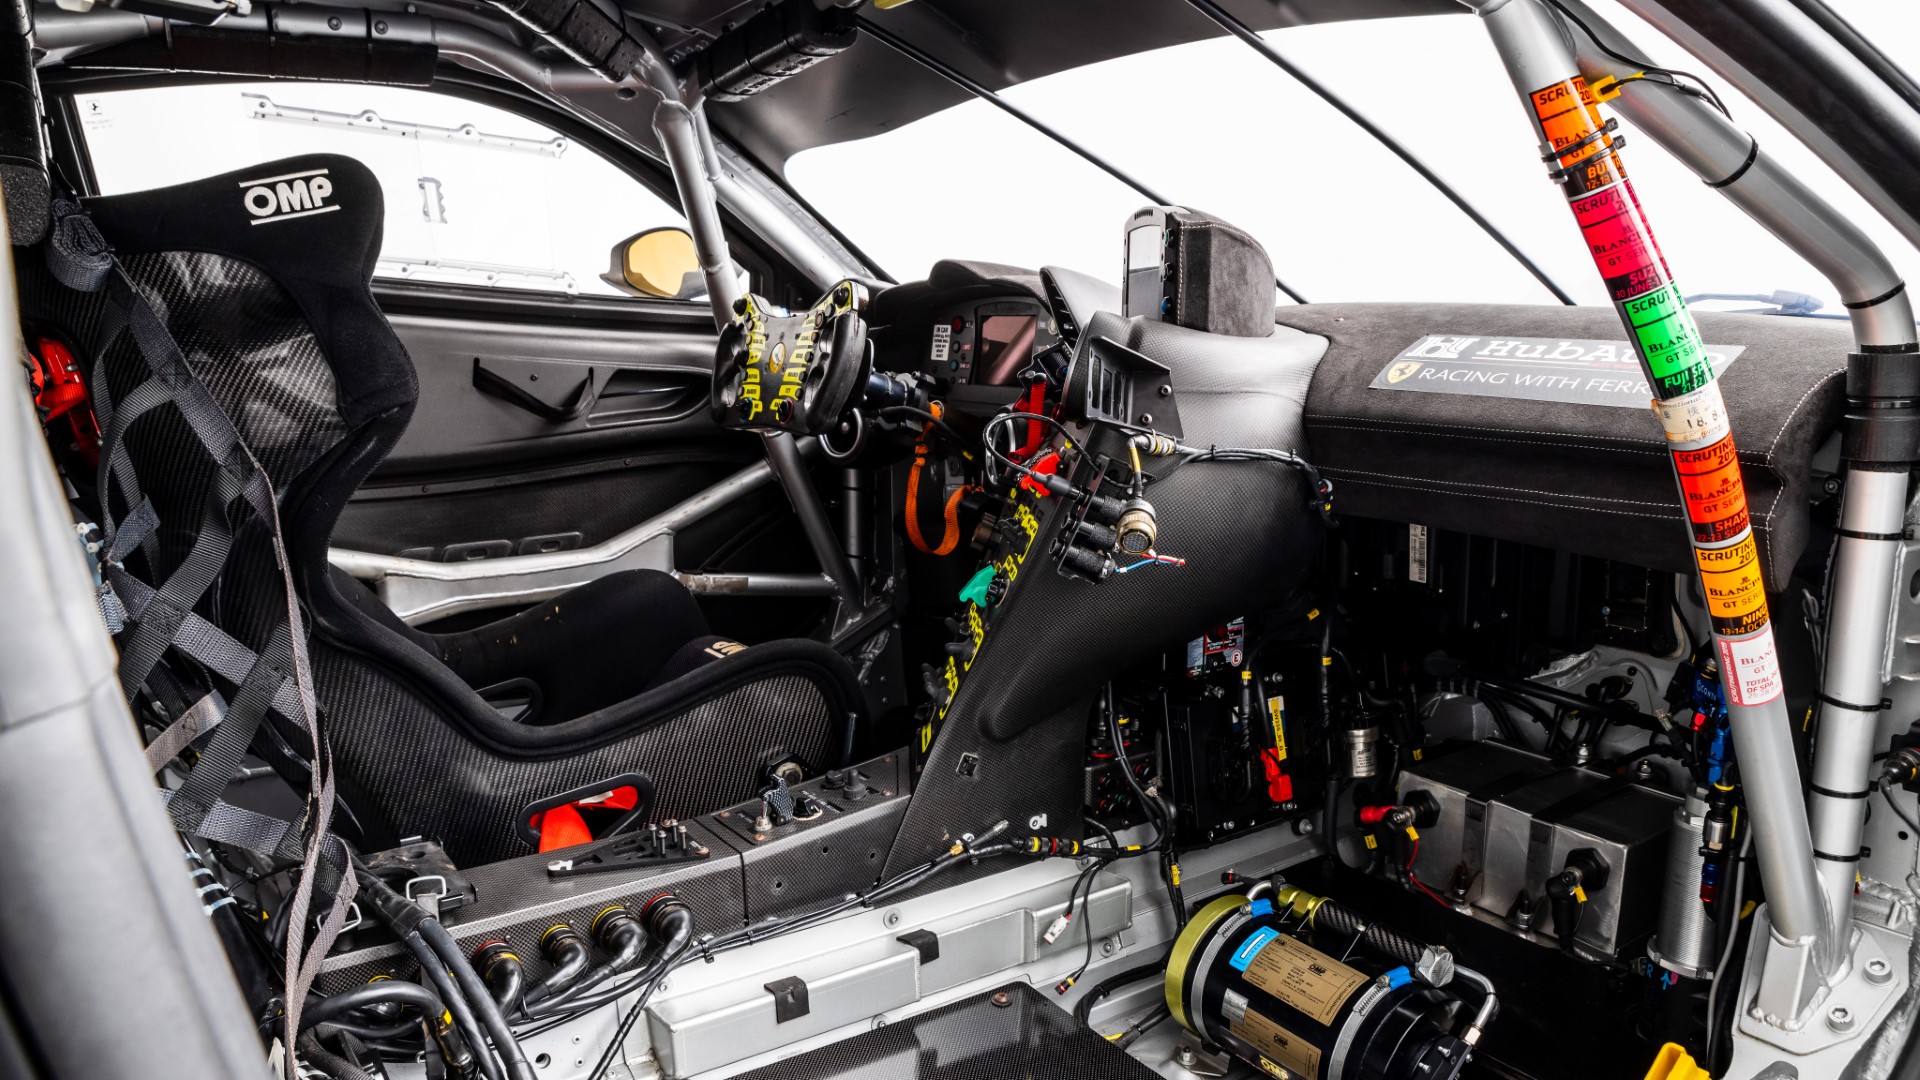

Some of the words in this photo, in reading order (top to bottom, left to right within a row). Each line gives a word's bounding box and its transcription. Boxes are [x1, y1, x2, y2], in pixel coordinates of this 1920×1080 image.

[243, 175, 333, 217] OMP
[1608, 256, 1622, 266] GT
[1615, 289, 1627, 300] 30
[1665, 352, 1680, 364] GT
[1417, 367, 1509, 384] RACING
[1514, 374, 1581, 390] WITH
[1585, 378, 1653, 394] FERR
[1665, 369, 1690, 389] FUJI
[1703, 504, 1718, 514] GT
[1696, 531, 1722, 542] 22-23
[1723, 600, 1738, 609] GT
[1721, 627, 1745, 635] 13-14
[1754, 665, 1765, 674] GT
[1745, 676, 1770, 686] TOTAL
[1760, 681, 1774, 691] SPA
[1308, 963, 1326, 974] OMP
